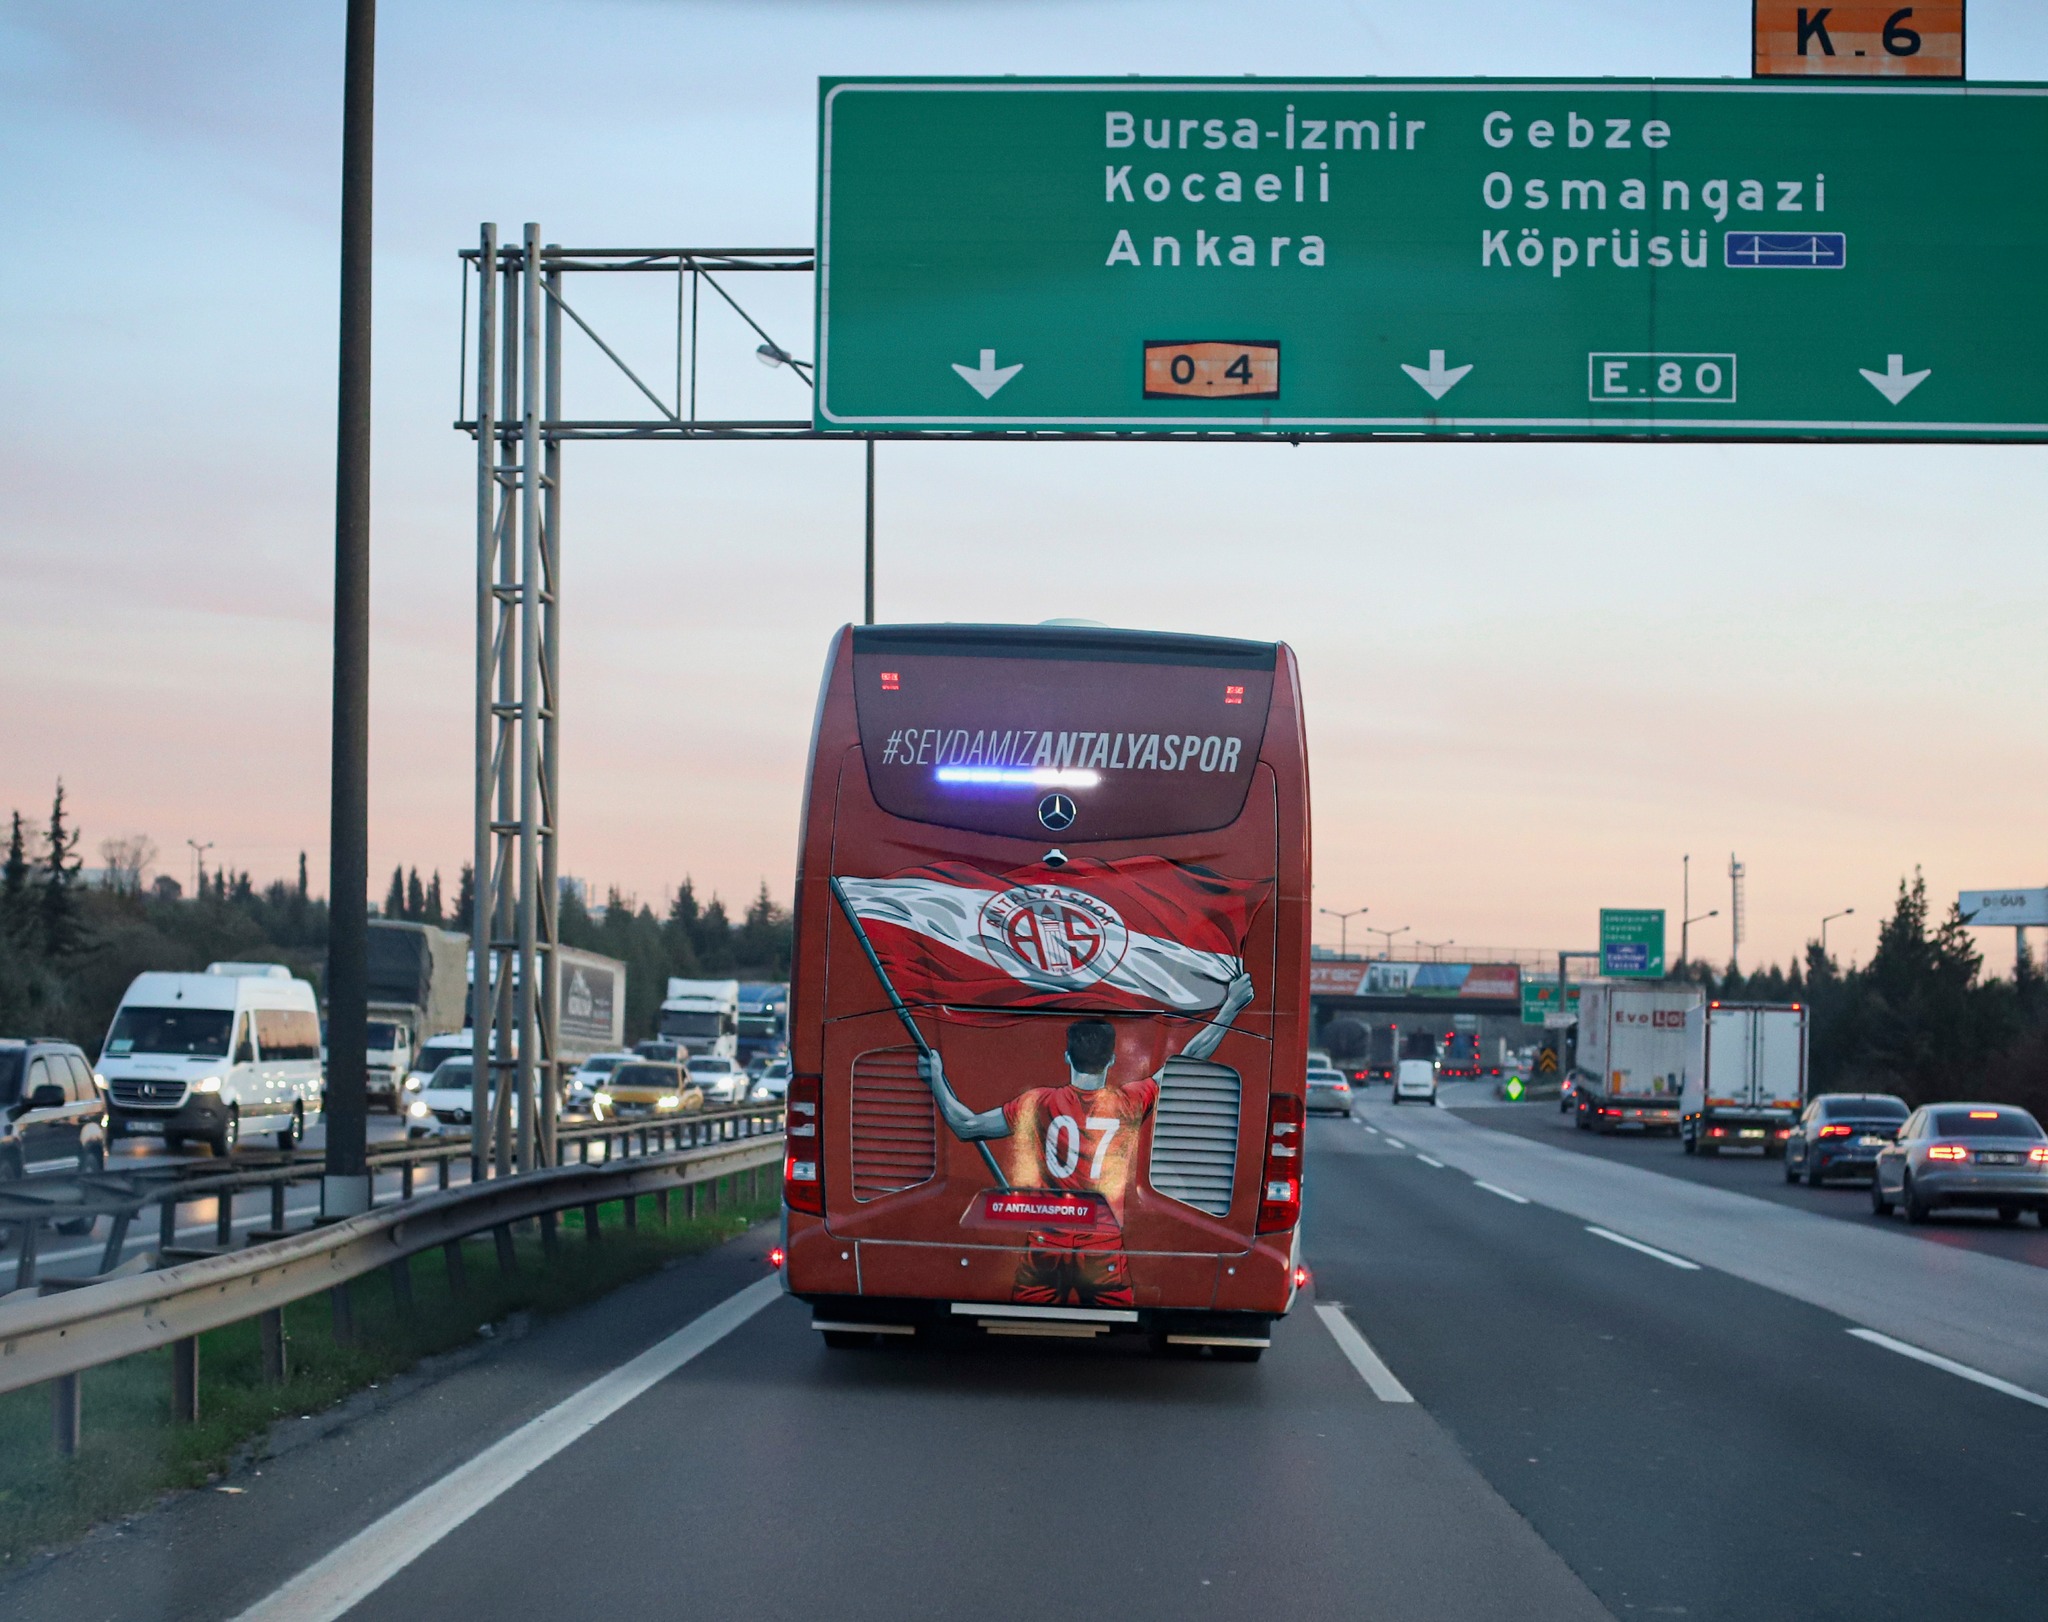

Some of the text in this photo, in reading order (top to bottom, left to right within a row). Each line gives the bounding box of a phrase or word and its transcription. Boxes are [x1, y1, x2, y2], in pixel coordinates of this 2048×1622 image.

[1796, 6, 1922, 57] K.6
[1105, 104, 1426, 150] Bursa-İzmir
[1482, 110, 1671, 149] Gebze
[1105, 162, 1329, 203] Kocaeli
[1482, 171, 1825, 223] Osmangazi
[1105, 229, 1325, 267] Ankara
[1482, 228, 1708, 278] Köprüsü
[1603, 361, 1722, 394] E.80
[882, 729, 1242, 773] #SEVDAMIZANTALYASPOR
[986, 888, 1116, 929] ANTALYASPOR
[1045, 1114, 1120, 1179] 07
[992, 1202, 1088, 1216] 07 ANTALYASPOR 07
